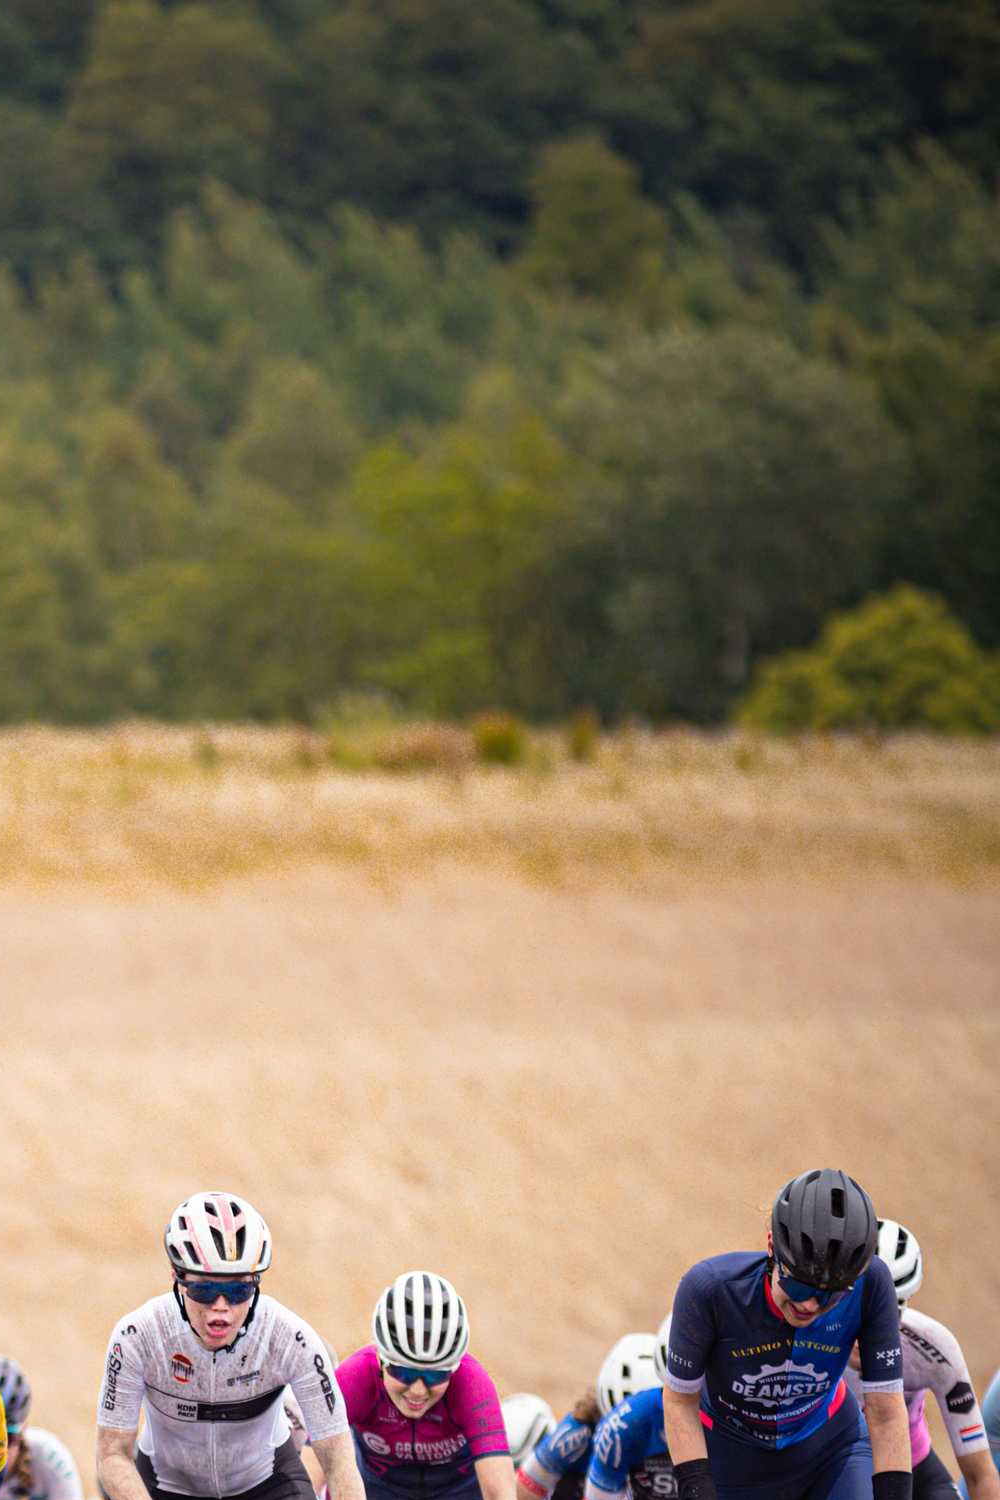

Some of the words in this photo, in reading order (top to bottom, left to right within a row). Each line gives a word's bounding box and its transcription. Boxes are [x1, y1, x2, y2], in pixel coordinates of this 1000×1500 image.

[732, 1341, 781, 1357] ULTIMO
[786, 1339, 841, 1354] VASTGOED
[901, 1328, 953, 1367] GIANT
[105, 1355, 122, 1411] Stanza
[731, 1380, 756, 1397] DE
[757, 1380, 832, 1397] AMSTEL
[177, 1403, 197, 1412] KDM
